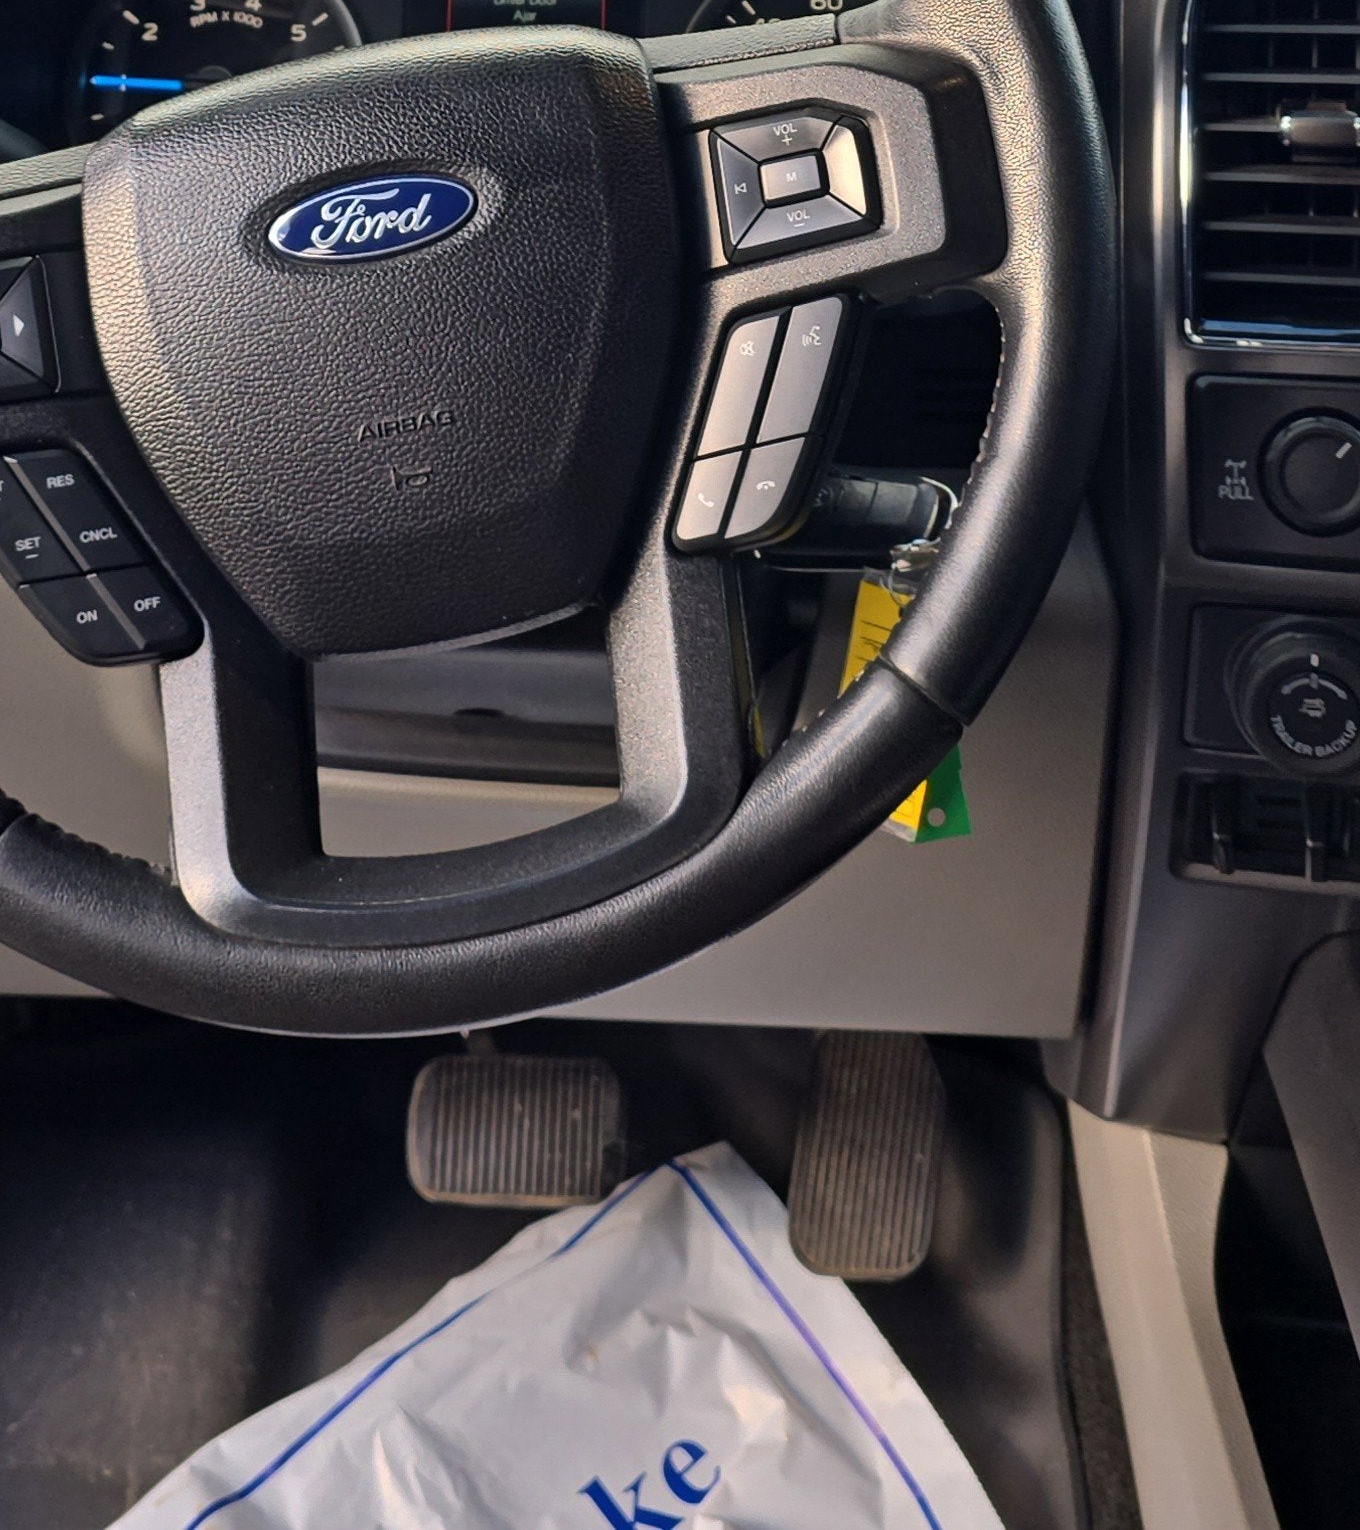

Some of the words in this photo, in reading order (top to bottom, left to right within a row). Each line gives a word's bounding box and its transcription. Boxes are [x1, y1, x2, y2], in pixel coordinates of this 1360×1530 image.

[190, 10, 218, 28] RPM
[233, 11, 264, 29] 1000
[141, 22, 159, 41] 2
[290, 24, 307, 42] 5
[772, 123, 798, 136] VOL
[786, 171, 798, 184] M
[310, 187, 432, 250] Ford
[786, 209, 811, 223] VOL
[357, 410, 456, 443] AIRBAG
[46, 474, 75, 489] RES
[79, 526, 118, 544] CNCL
[15, 537, 41, 552] SET
[134, 595, 162, 612] OFF
[76, 609, 99, 624] ON
